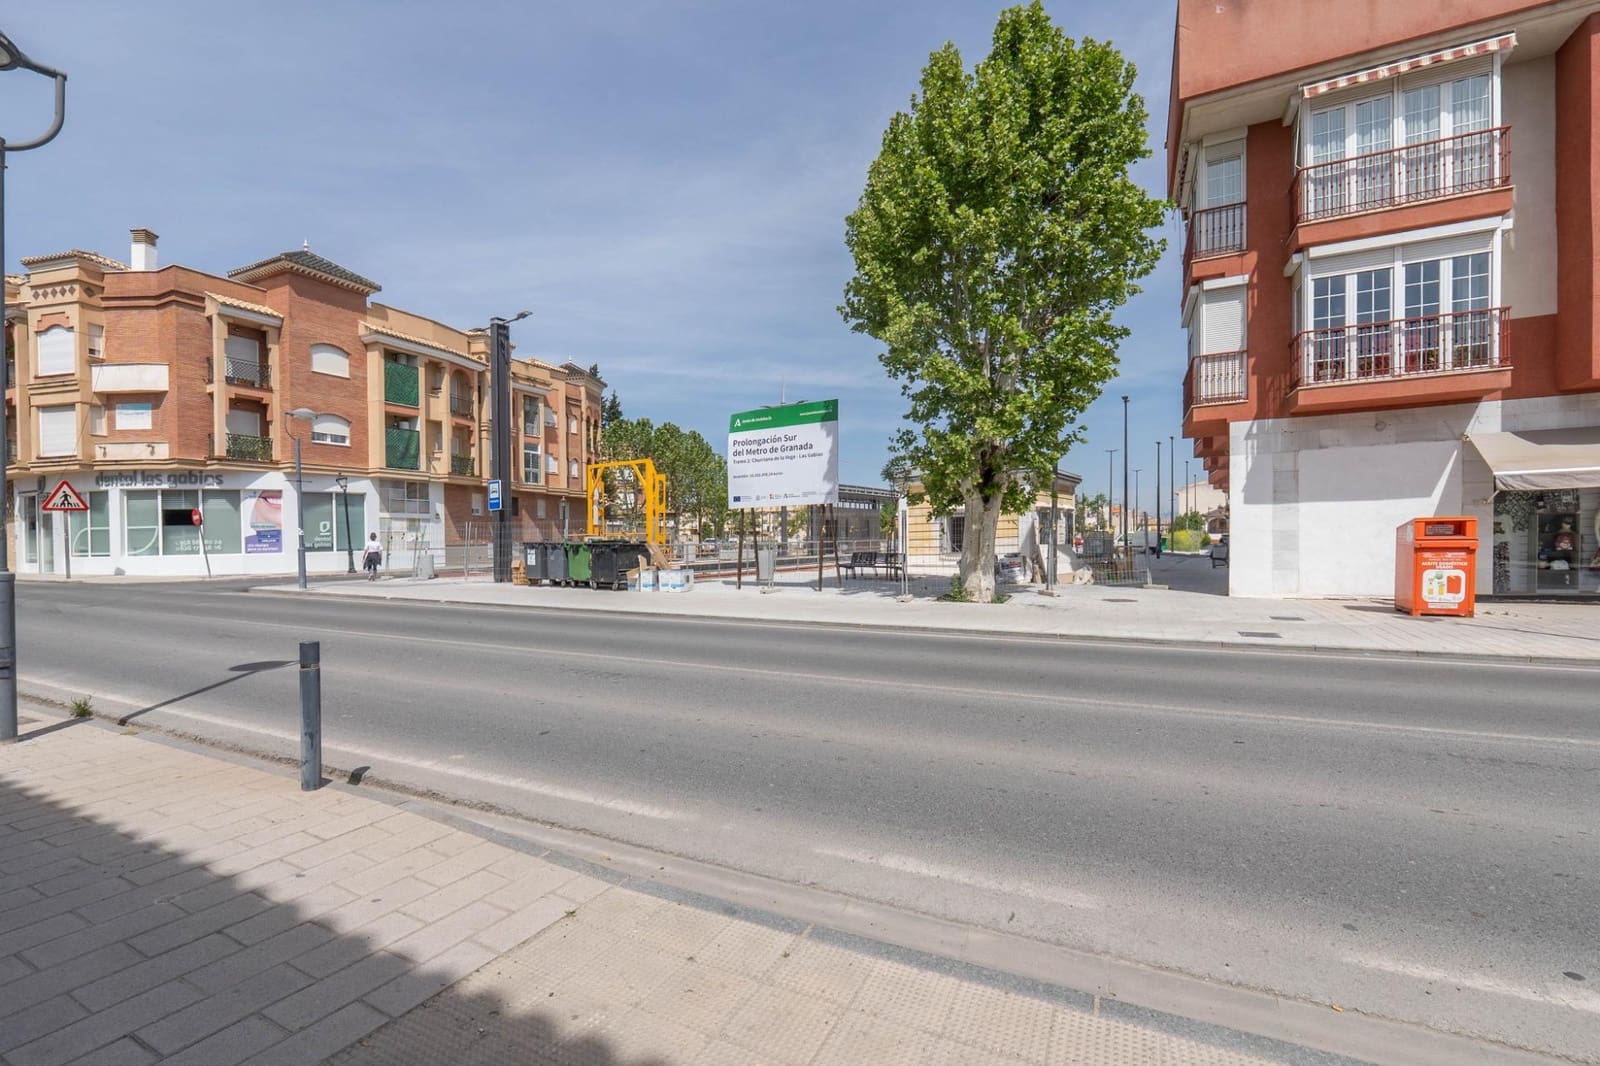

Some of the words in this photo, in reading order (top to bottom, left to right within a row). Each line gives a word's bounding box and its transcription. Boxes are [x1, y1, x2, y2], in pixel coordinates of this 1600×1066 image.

[732, 434, 783, 447] Prolongación
[783, 434, 797, 442] Sur
[732, 448, 745, 457] del
[745, 447, 768, 456] Metro
[769, 446, 779, 454] de
[780, 442, 814, 452] Granada
[95, 471, 138, 488] dental
[141, 471, 163, 488] las
[167, 470, 224, 489] gabias
